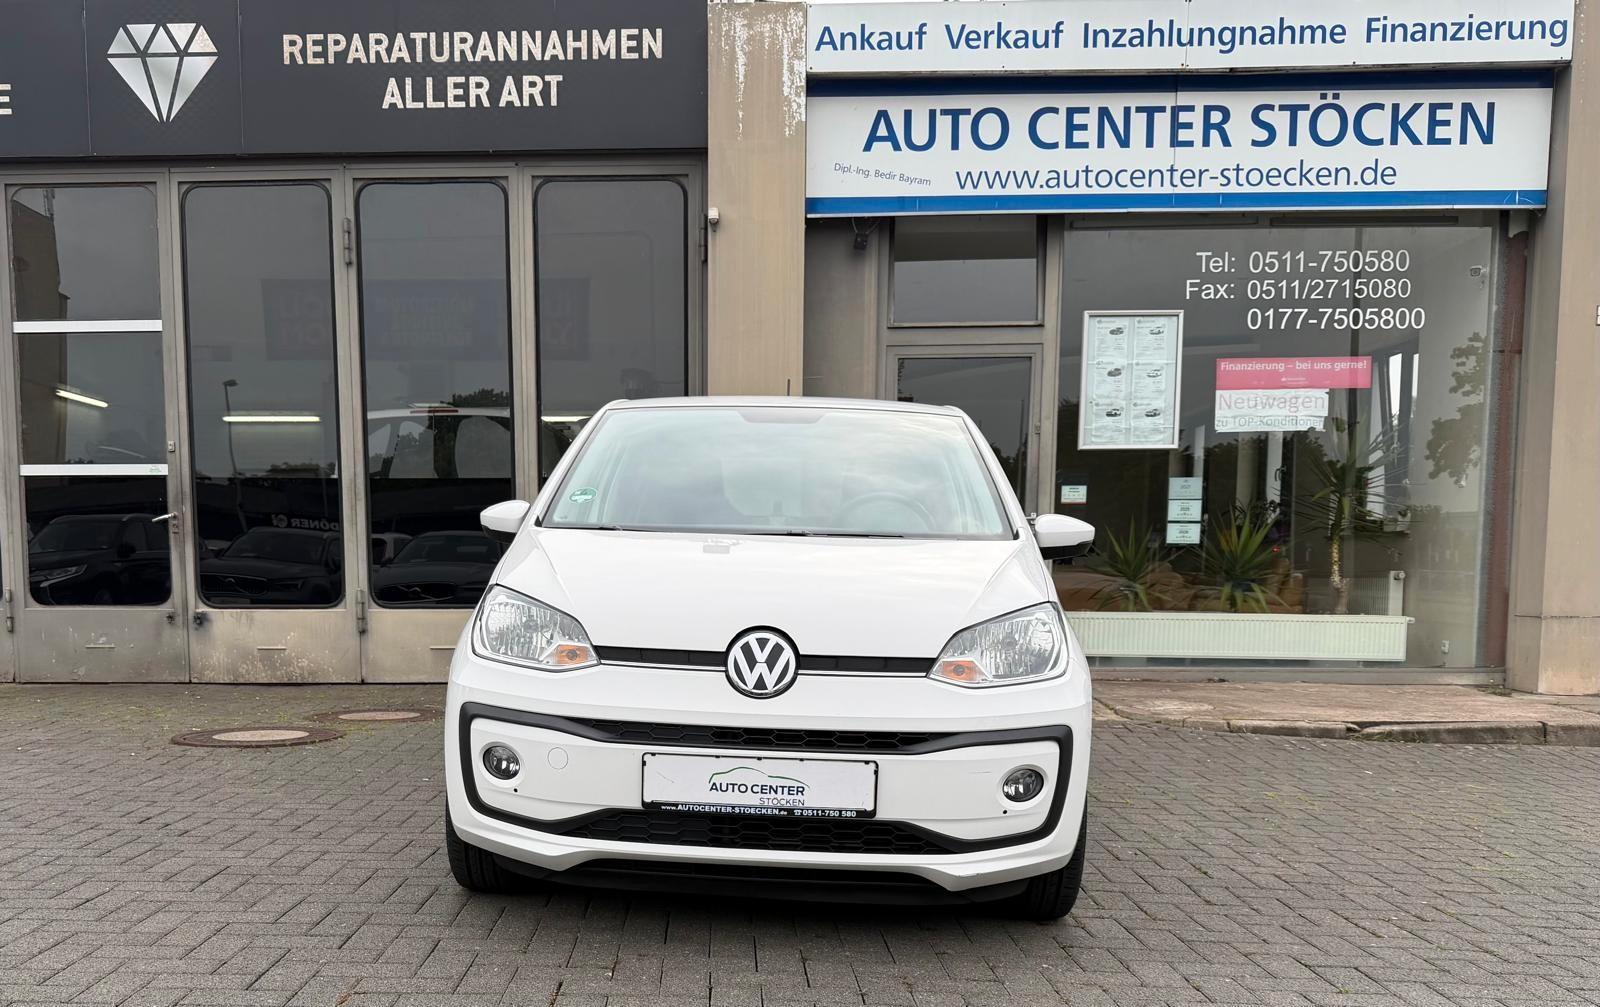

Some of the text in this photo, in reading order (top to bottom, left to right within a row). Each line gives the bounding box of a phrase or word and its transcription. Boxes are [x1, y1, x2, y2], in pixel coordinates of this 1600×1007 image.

[815, 14, 1568, 54] Ankauf Verkauf Inzahlungnahme Finanzierung
[282, 28, 663, 64] REPARATURANNAHMEN
[382, 75, 563, 108] ALLER ART
[863, 92, 1495, 152] AUTO CENTER STÖCKEN
[834, 162, 931, 186] Dipl.-Ing. Bedir Bayram
[955, 158, 1397, 190] www.autocenter-stoecken.de
[1196, 250, 1410, 273] Tel: 0511-750580
[1186, 278, 1412, 299] Fax: 0511/2715080
[1247, 307, 1426, 330] 0177-7505800
[1220, 361, 1285, 372] Finanzierung
[1296, 360, 1311, 370] bei
[1314, 362, 1331, 370] uns
[1335, 359, 1367, 371] gerne!
[1218, 393, 1326, 413] Neuwagen
[709, 782, 805, 796] AUTO CENTER
[661, 804, 857, 818] www.AUTOCENTER-STOECKEN.de 0511-750 580
[759, 797, 805, 807] STÖCKEN
